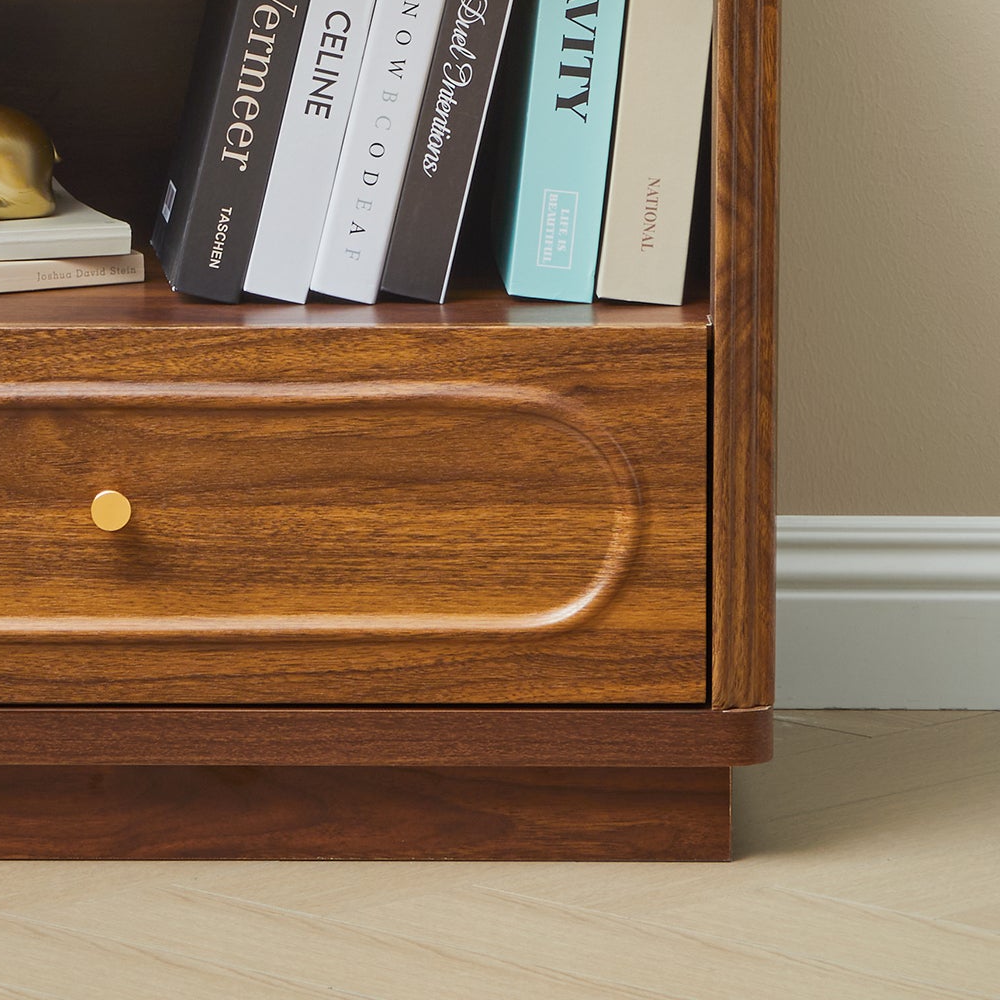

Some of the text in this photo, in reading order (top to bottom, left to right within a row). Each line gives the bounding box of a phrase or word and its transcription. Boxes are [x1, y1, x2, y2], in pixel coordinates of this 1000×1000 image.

[304, 10, 351, 120] CELINE
[422, 62, 473, 178] Intentions
[208, 206, 233, 269] TASCHEN
[641, 177, 661, 253] NATIONAL
[36, 265, 137, 282] Joshua David Stein
